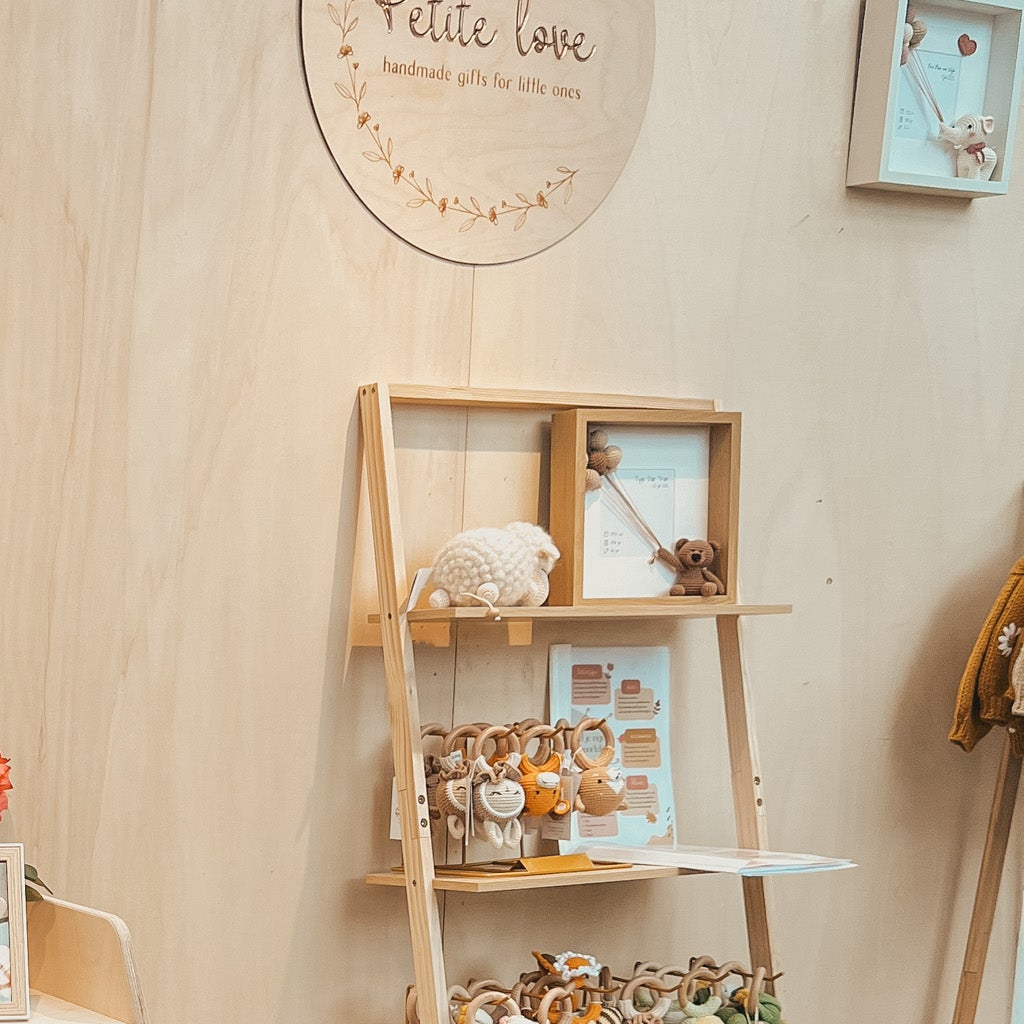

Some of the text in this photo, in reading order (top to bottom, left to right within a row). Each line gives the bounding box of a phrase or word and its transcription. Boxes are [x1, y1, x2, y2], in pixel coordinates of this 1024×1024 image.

[515, 0, 597, 62] love
[383, 56, 582, 101] handmade gifts for little ones
